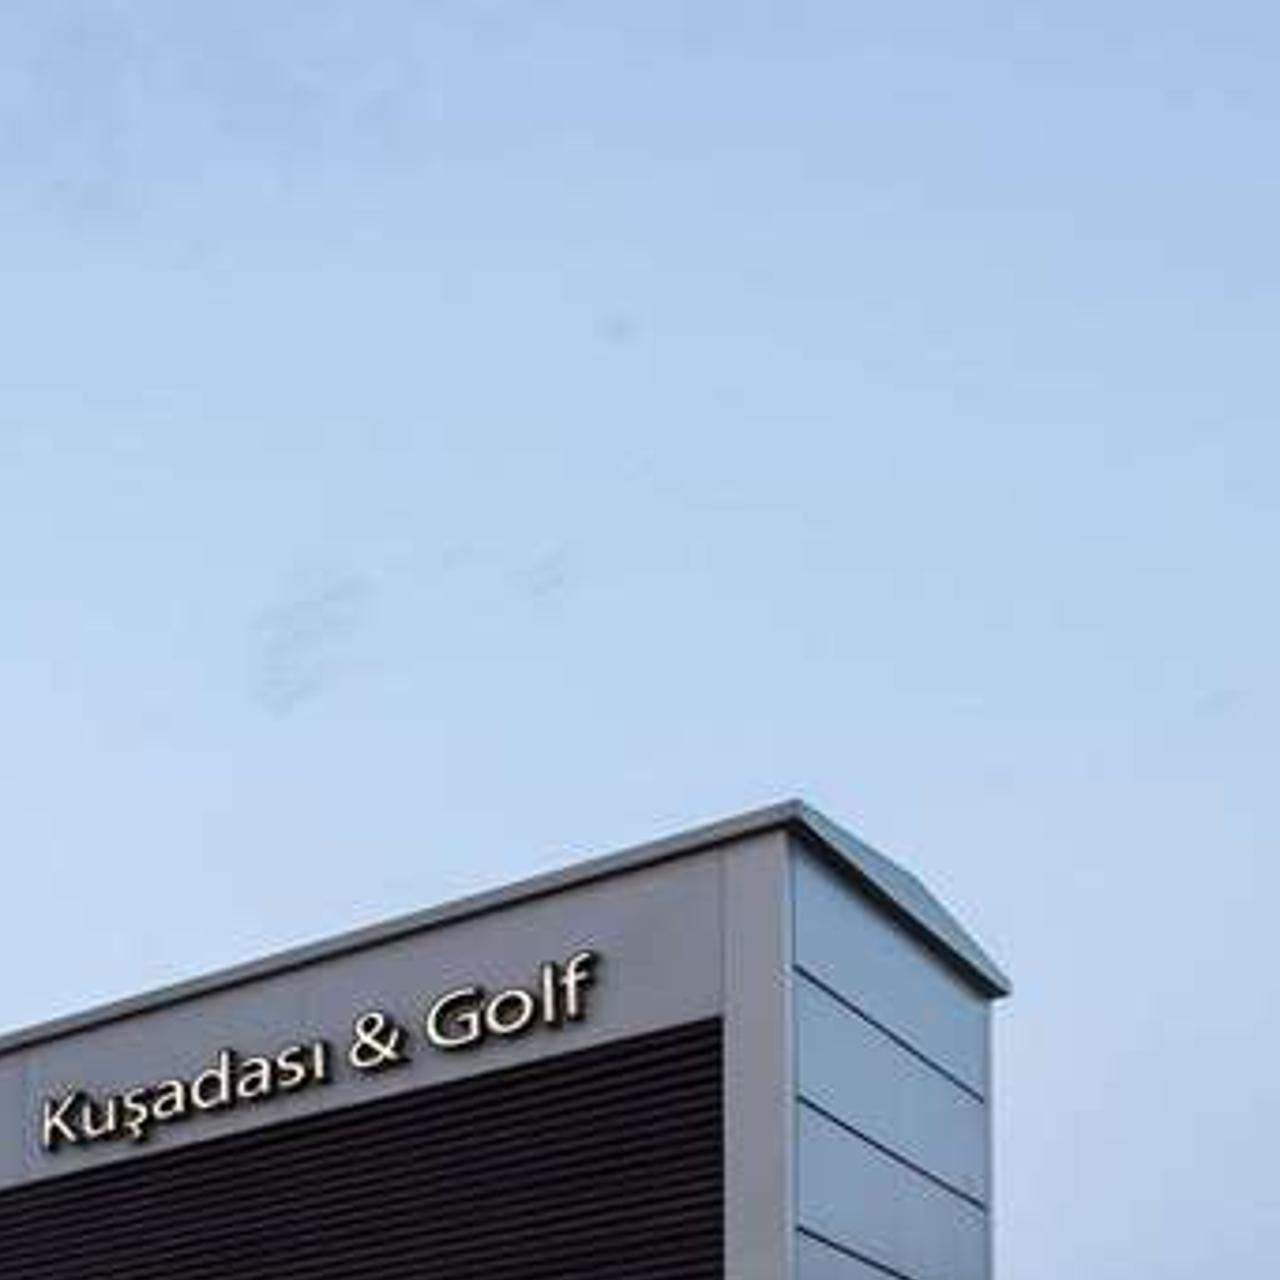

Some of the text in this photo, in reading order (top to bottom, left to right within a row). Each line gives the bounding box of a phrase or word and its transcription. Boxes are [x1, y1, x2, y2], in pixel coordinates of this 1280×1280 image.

[40, 950, 598, 1150] Kuşadası & Golf
